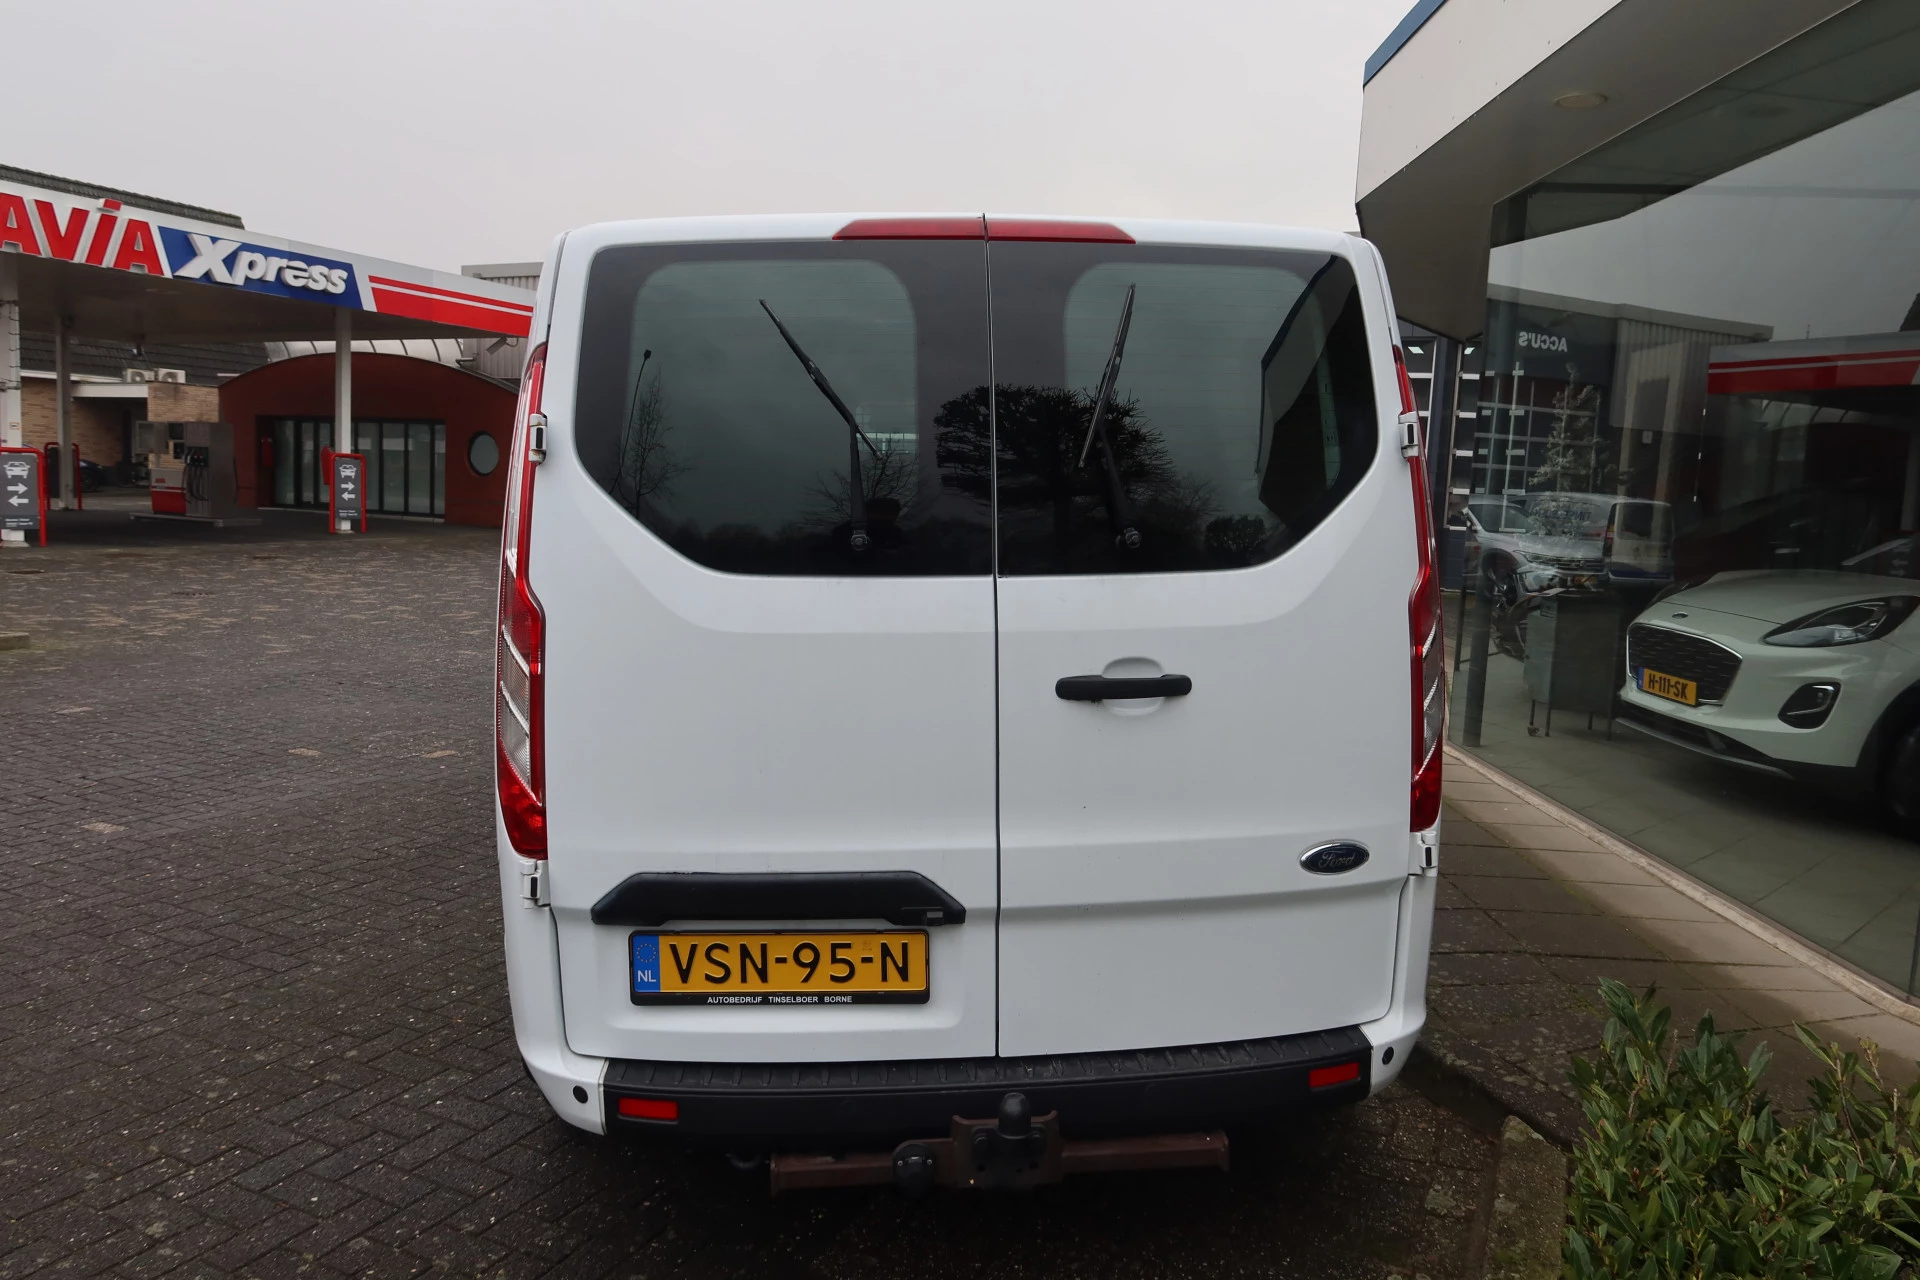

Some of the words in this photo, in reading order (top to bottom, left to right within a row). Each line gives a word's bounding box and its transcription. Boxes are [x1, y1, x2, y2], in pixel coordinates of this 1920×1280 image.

[173, 232, 349, 295] Xpress
[1648, 672, 1689, 700] H-111-SK
[1318, 849, 1357, 869] Ford
[637, 969, 657, 983] NL
[668, 941, 909, 984] VSN-95-N
[706, 996, 763, 1004] AUTOBEDRIJF
[824, 995, 853, 1003] BORNE
